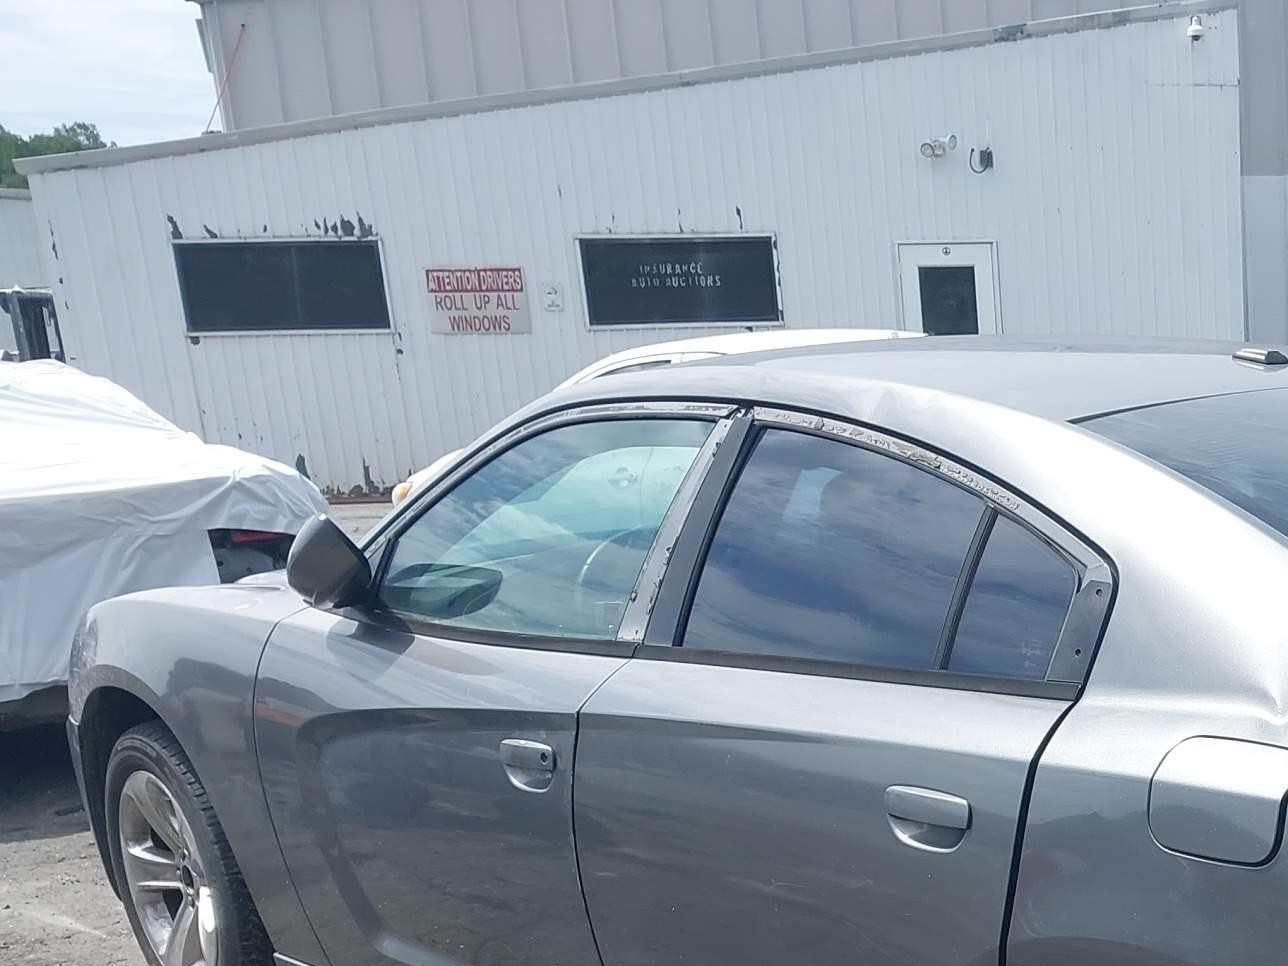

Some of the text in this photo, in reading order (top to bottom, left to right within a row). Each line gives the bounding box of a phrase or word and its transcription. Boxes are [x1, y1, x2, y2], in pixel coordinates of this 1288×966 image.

[639, 262, 703, 275] INSURANCE
[428, 270, 521, 291] ATTENTION DRIVERS
[631, 274, 721, 288] AUTO AUCTIONS
[434, 294, 521, 311] ROLL UP ALL
[448, 315, 511, 332] WINDOWS
